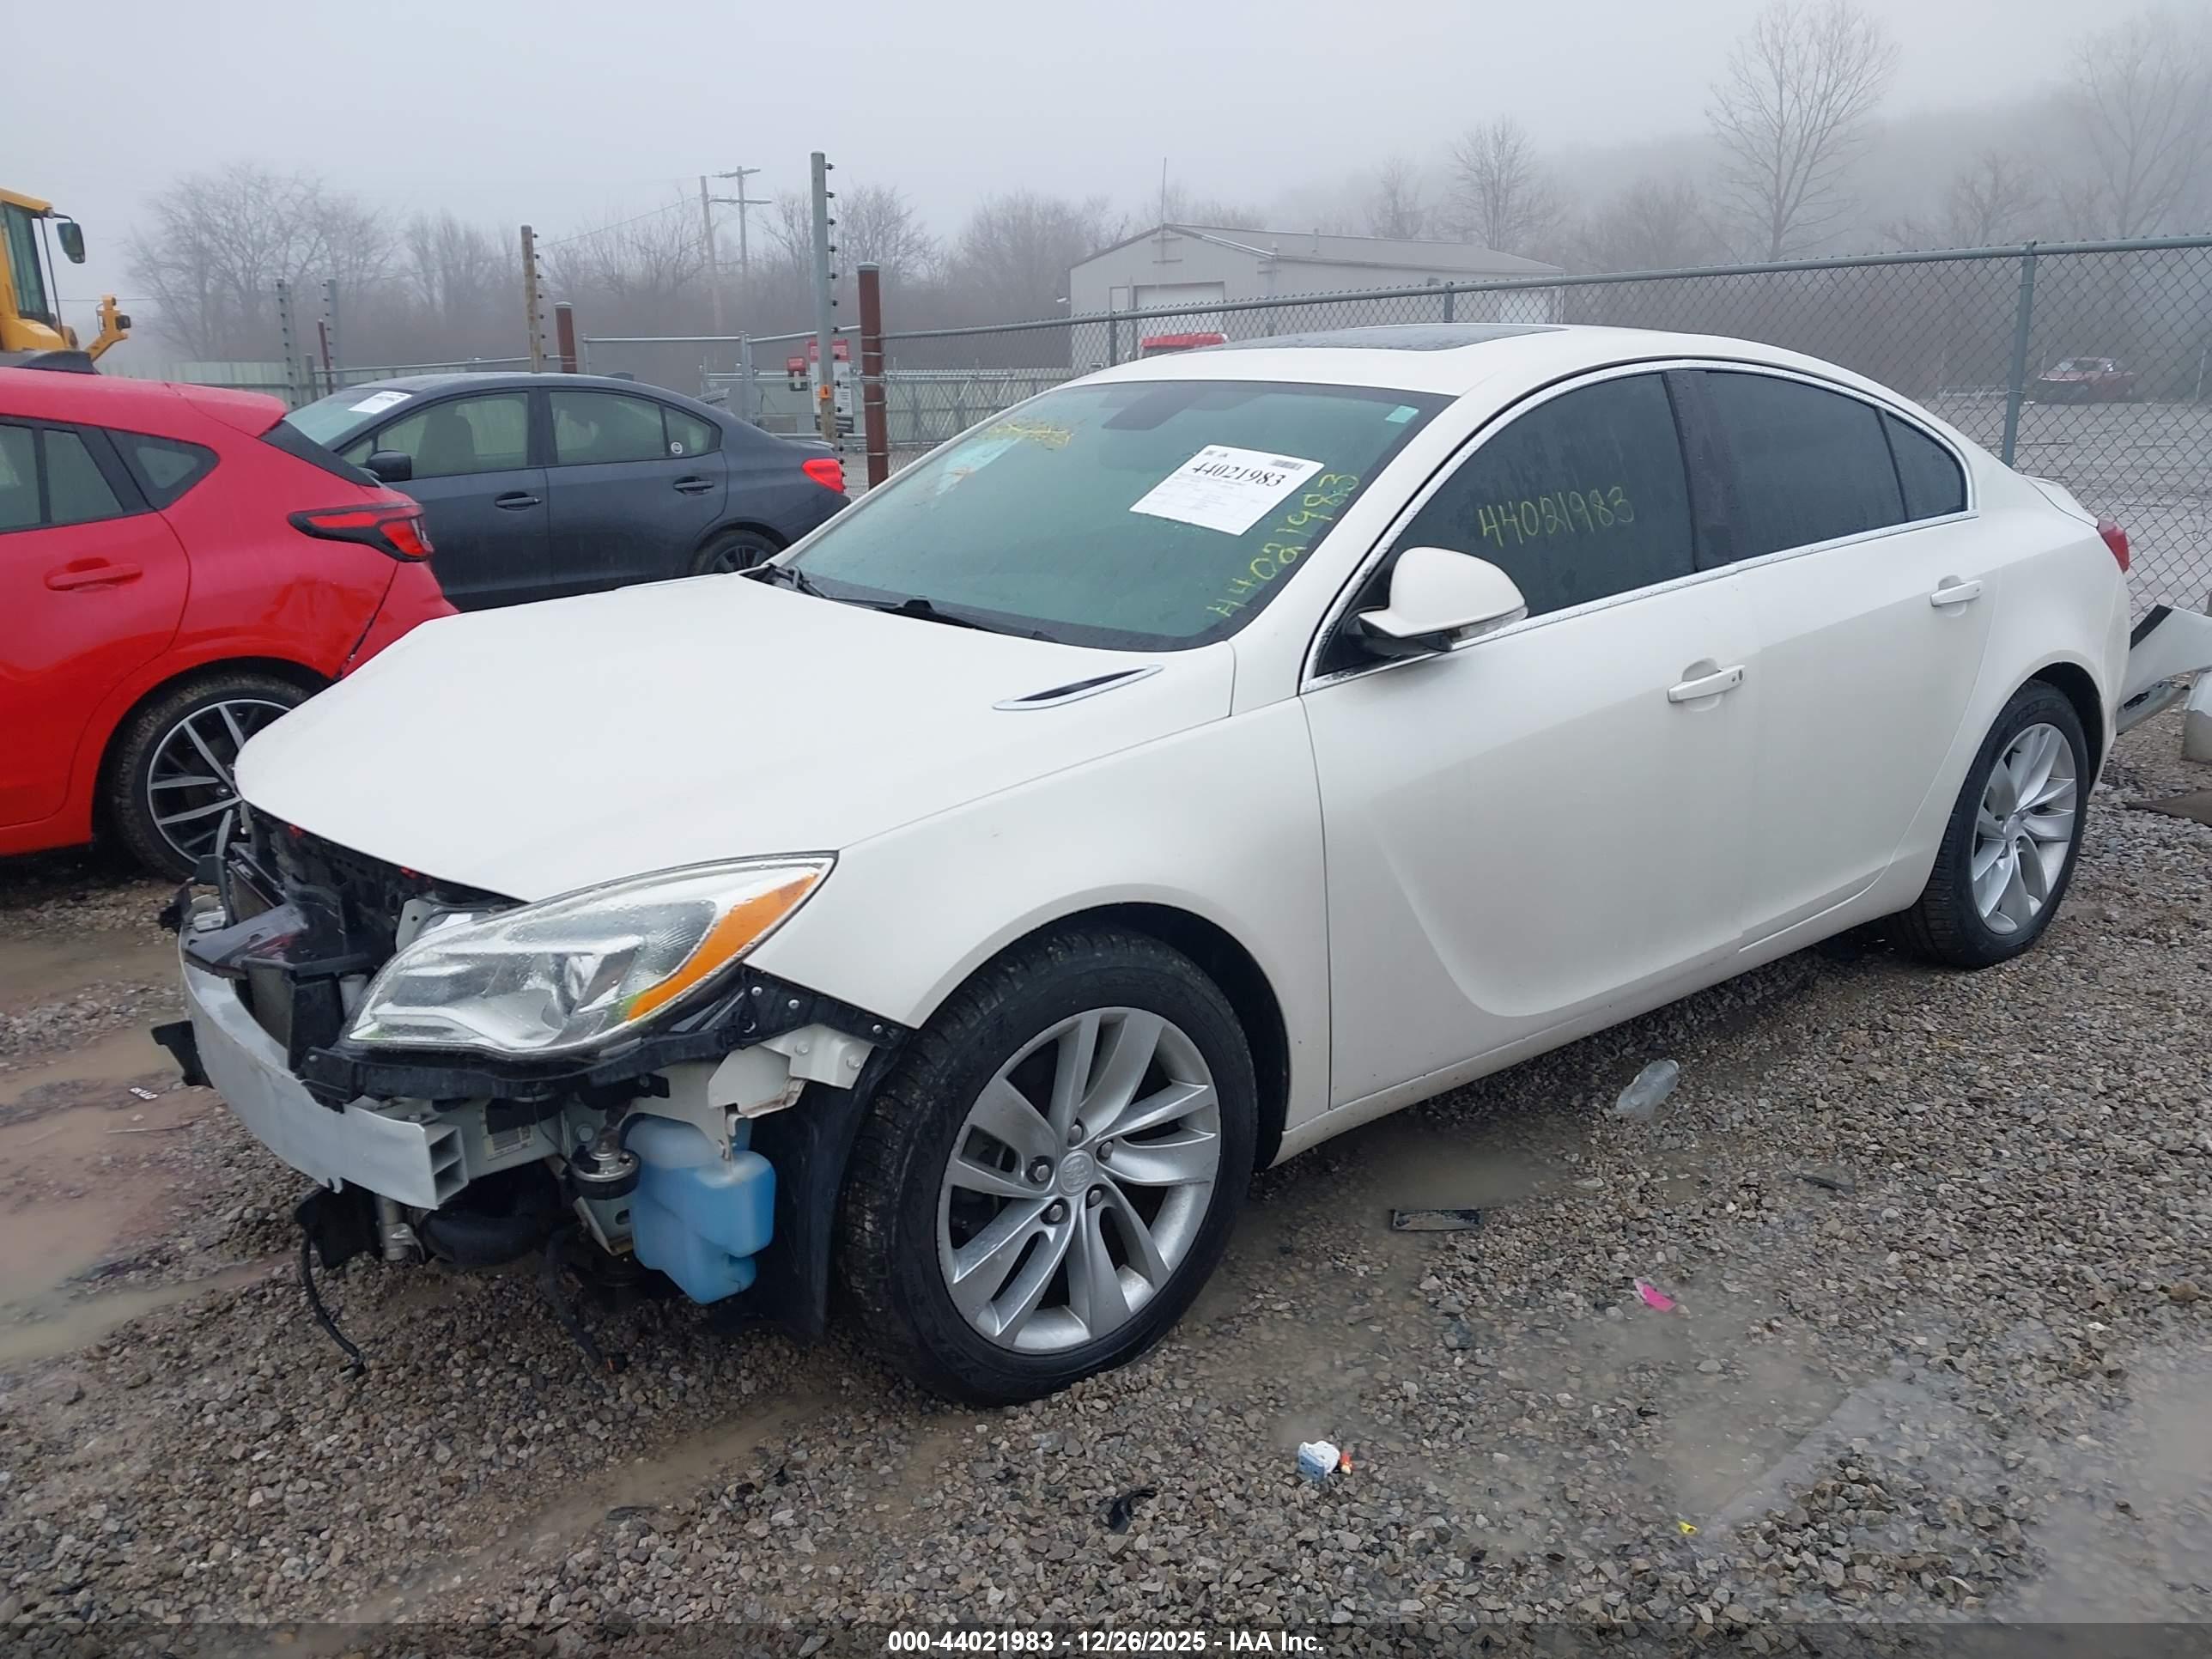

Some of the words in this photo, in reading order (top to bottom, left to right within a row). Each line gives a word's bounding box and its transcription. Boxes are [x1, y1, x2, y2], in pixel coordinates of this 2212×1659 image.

[1191, 461, 1287, 487] 44021983
[1206, 473, 1360, 617] 44021983
[1478, 485, 1635, 548] 44021983
